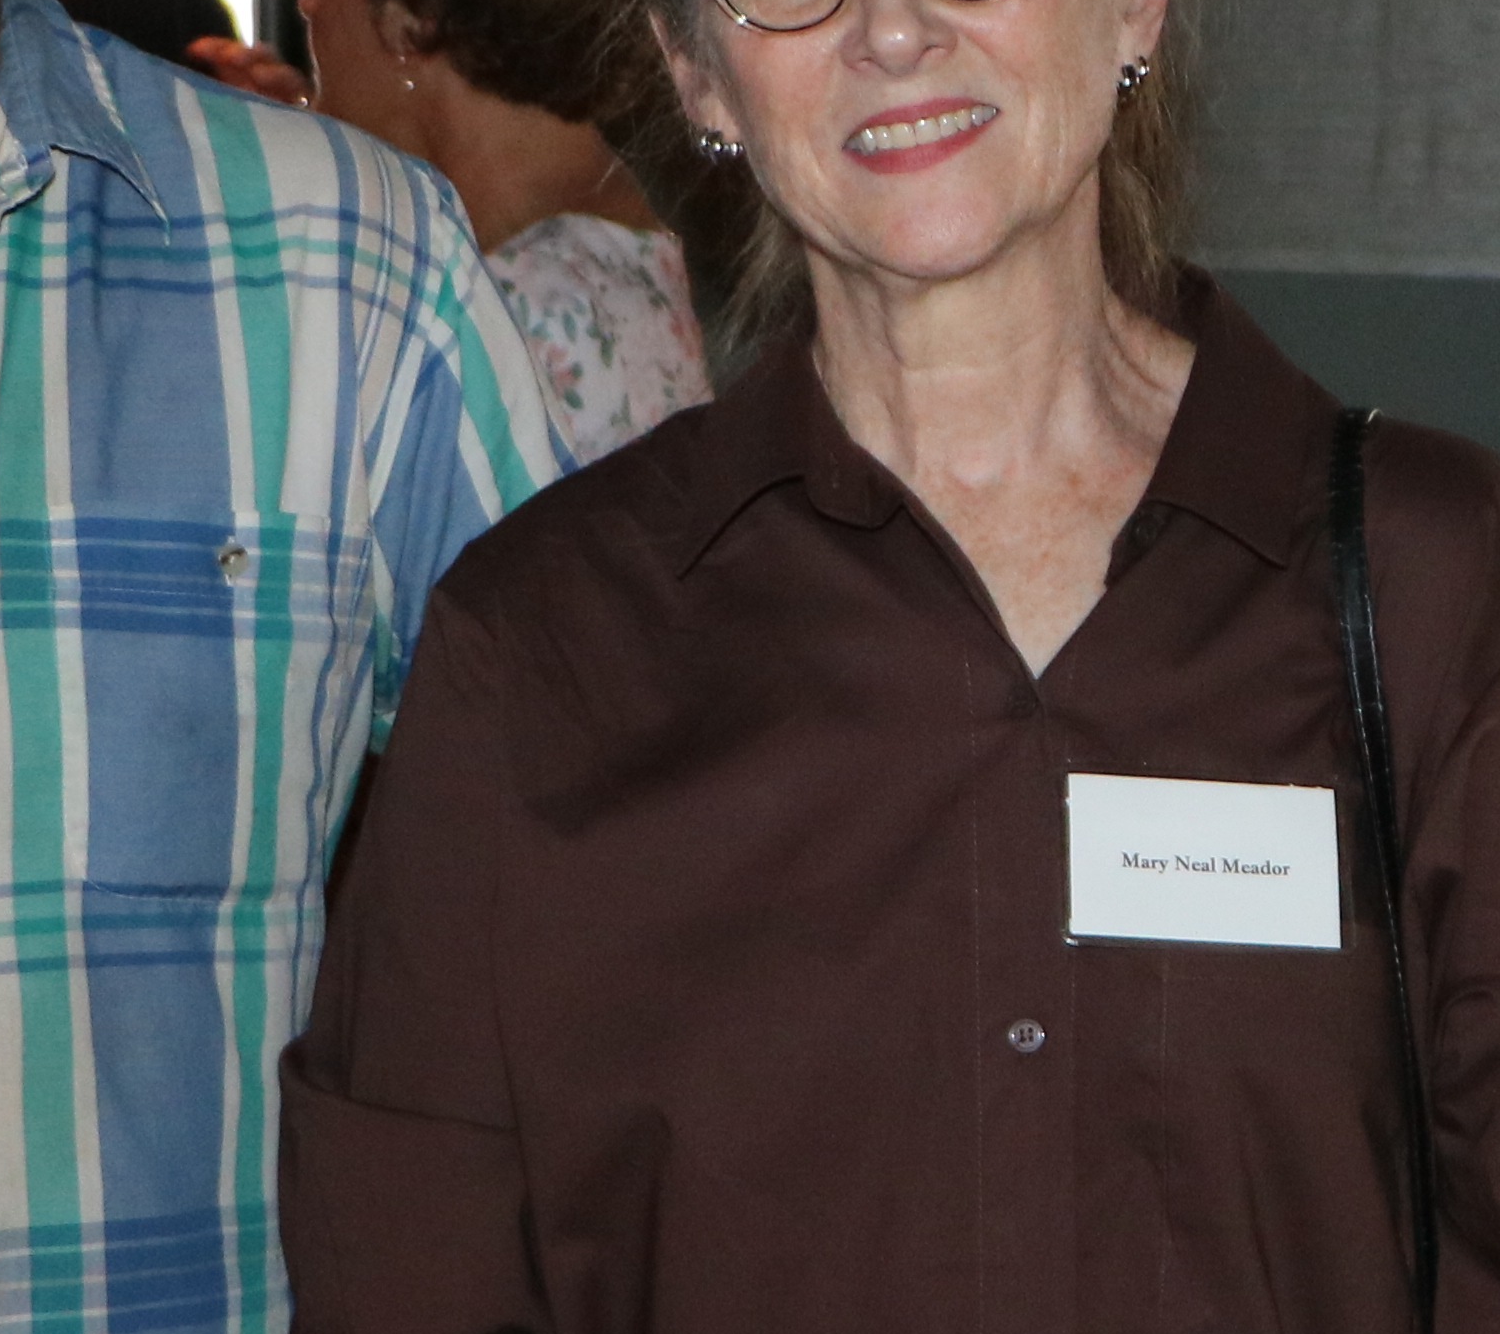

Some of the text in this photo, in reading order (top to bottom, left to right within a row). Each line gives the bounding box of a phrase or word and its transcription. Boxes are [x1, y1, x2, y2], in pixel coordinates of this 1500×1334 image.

[1121, 851, 1291, 876] Mary Neal Meador
